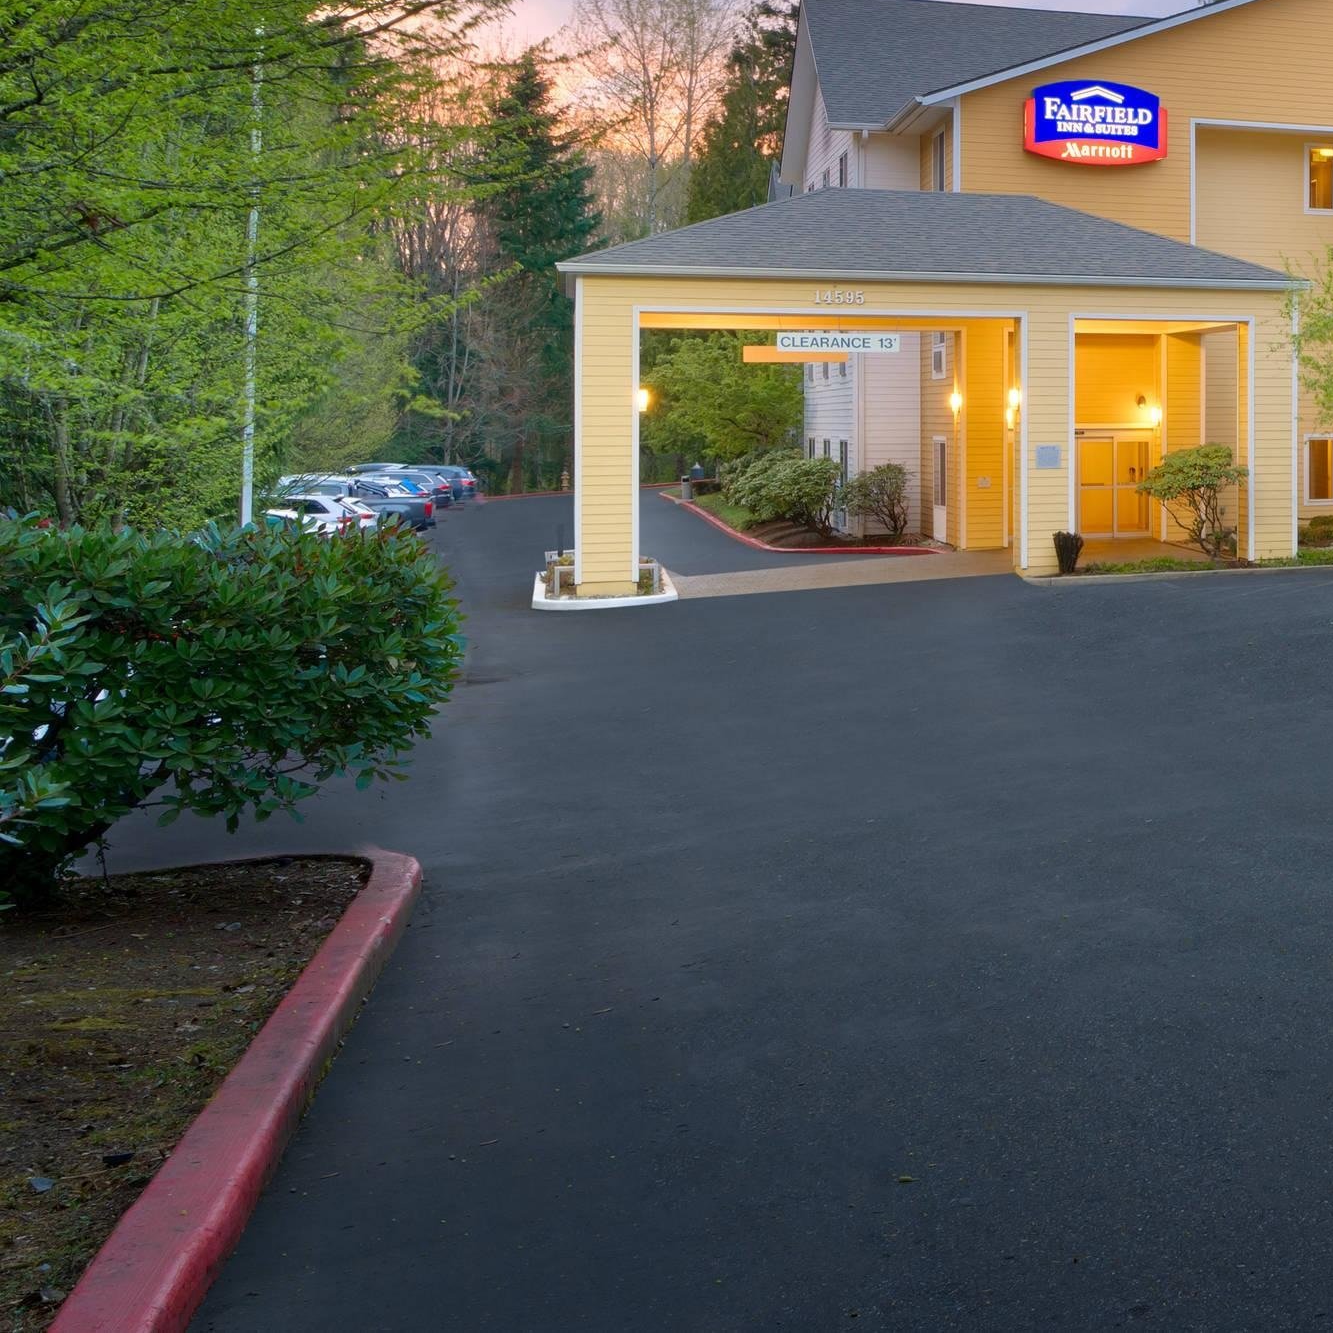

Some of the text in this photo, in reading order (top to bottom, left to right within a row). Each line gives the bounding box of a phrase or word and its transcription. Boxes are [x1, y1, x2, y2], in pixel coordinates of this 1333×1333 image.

[1043, 97, 1153, 125] FAIRFIELD
[1057, 121, 1139, 136] INN & SUITES
[1061, 142, 1133, 158] Marriott
[814, 290, 865, 305] 14595
[780, 336, 897, 349] CLEARANCE 13'
